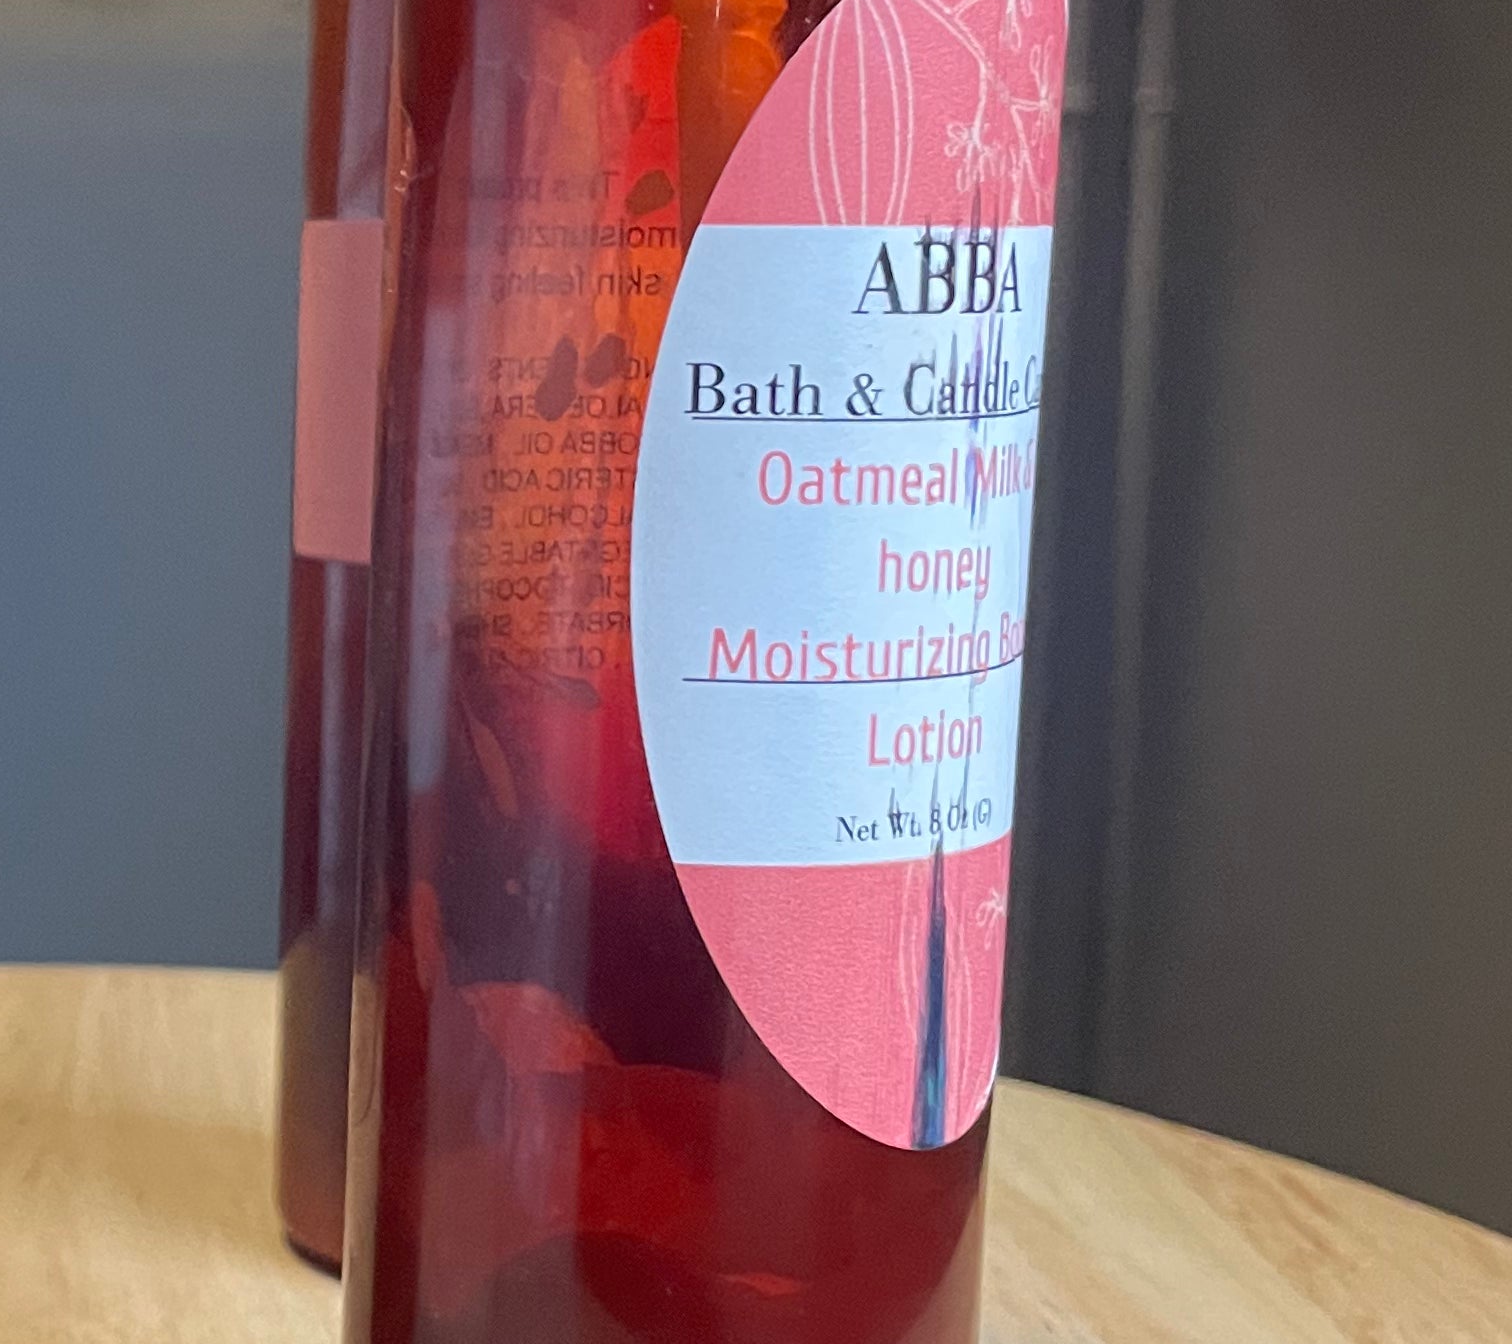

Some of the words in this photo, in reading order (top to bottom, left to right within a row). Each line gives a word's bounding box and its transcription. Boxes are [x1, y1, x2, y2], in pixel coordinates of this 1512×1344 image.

[851, 236, 1022, 315] ABBA
[685, 362, 824, 417] Bath
[845, 373, 882, 416] &
[903, 353, 1020, 416] Candle
[758, 448, 957, 505] Oatmeal
[878, 539, 991, 600] honey
[708, 621, 990, 685] Moisturizing
[868, 709, 982, 766] Lotion
[835, 813, 879, 844] Net
